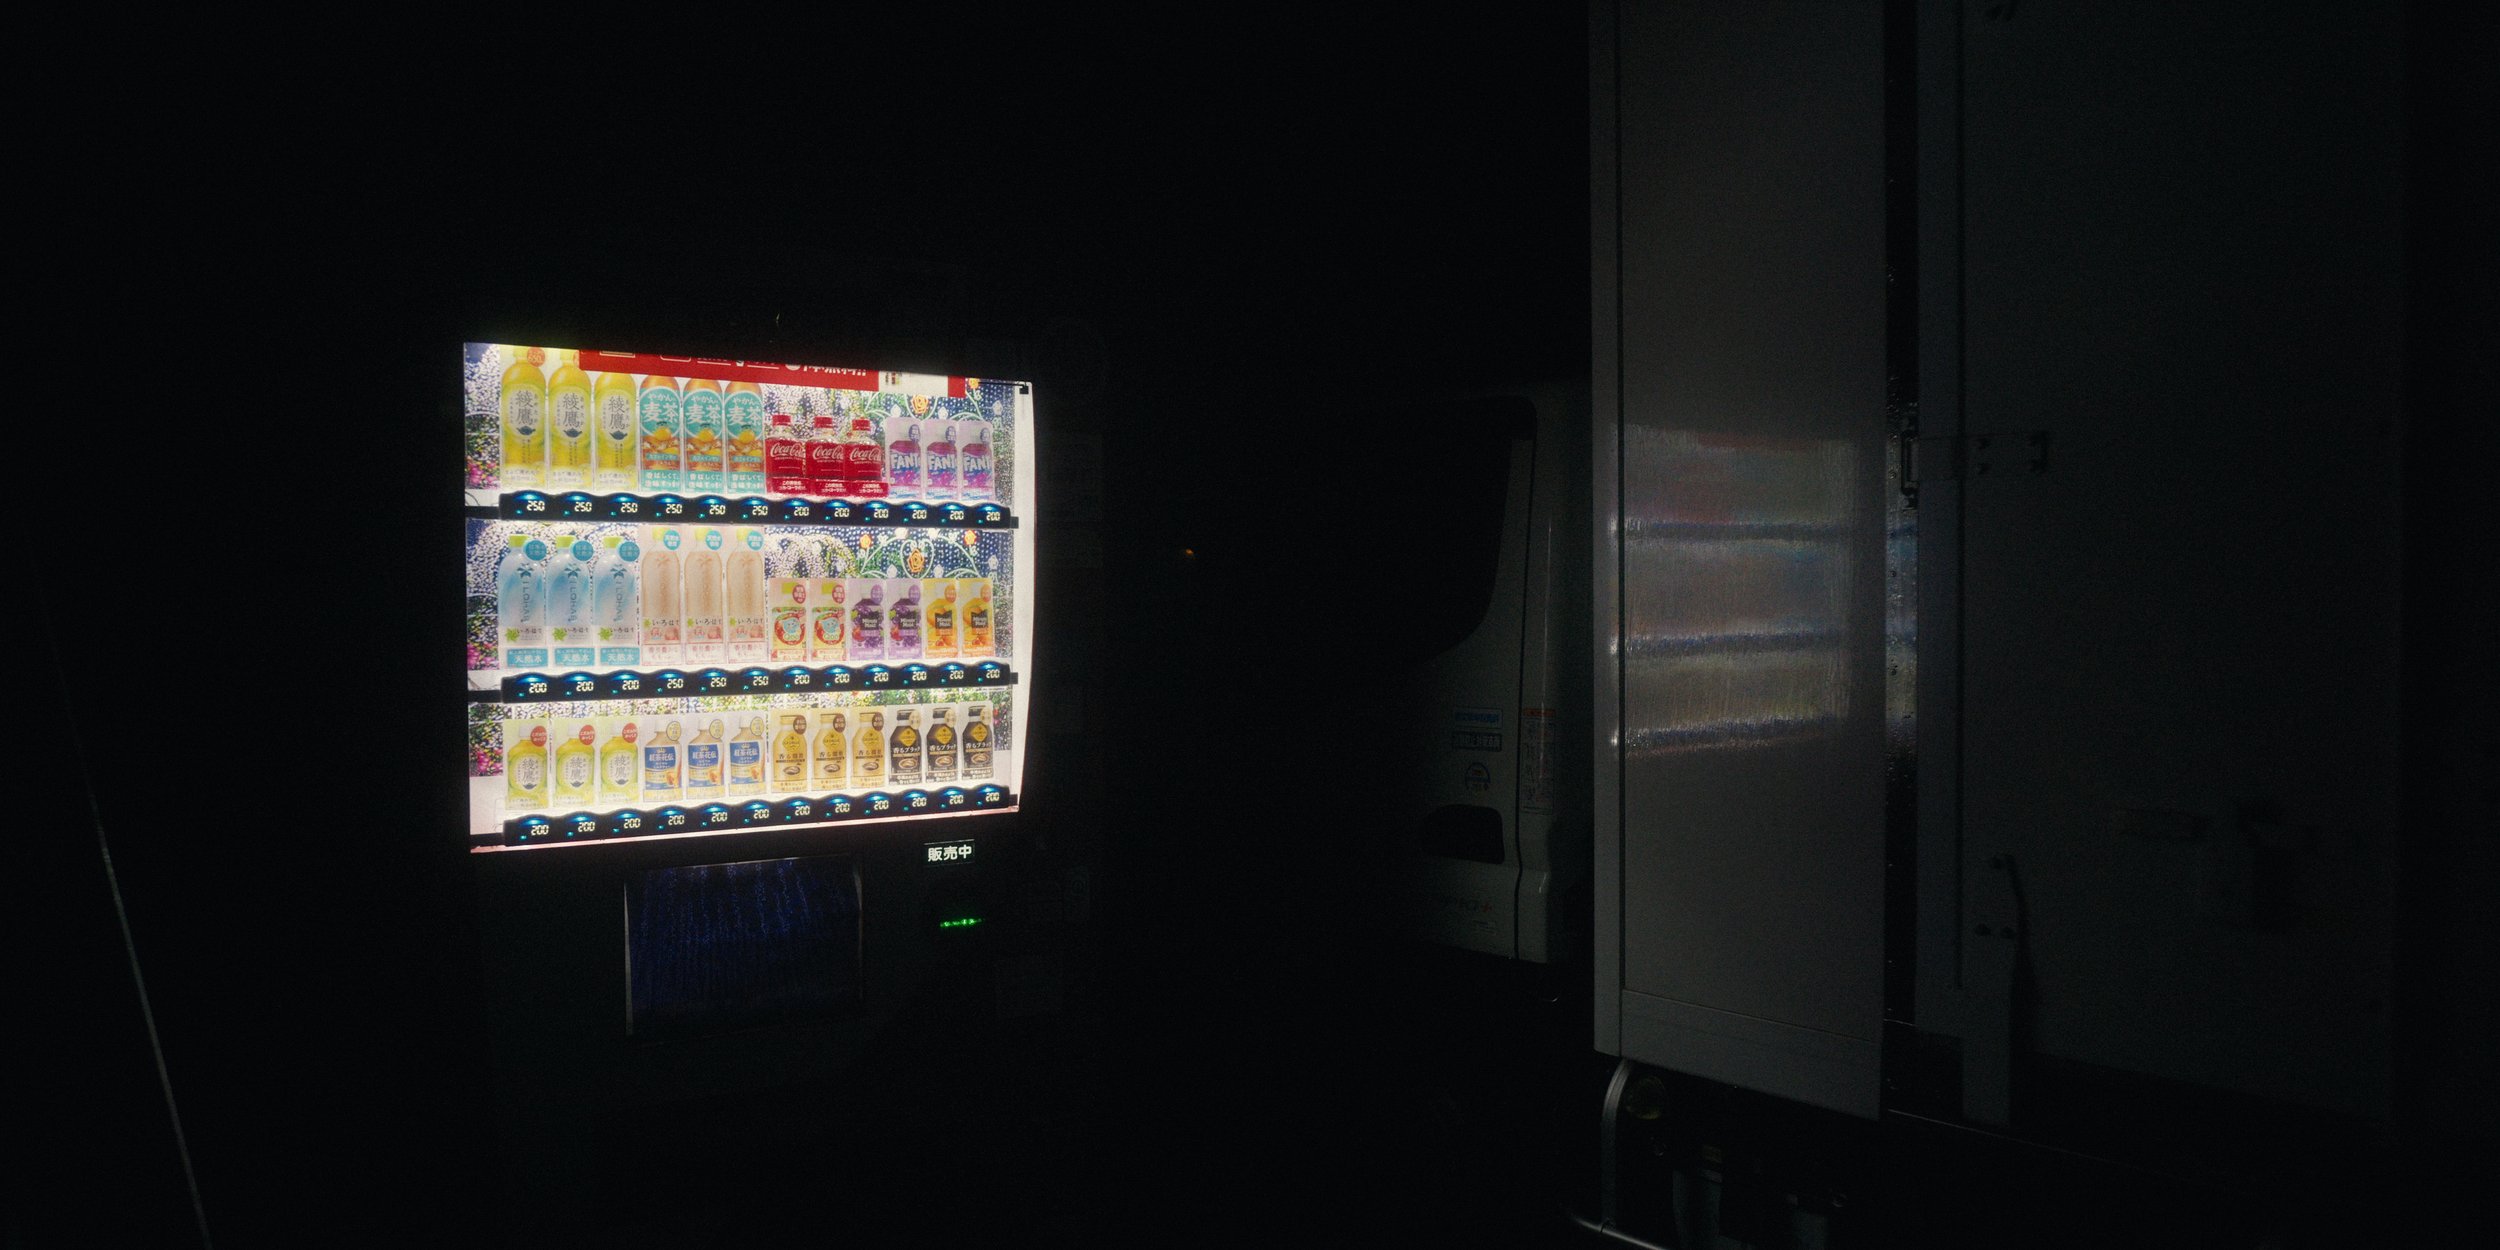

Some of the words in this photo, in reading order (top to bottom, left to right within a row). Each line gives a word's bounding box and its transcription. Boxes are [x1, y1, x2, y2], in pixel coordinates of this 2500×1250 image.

[515, 390, 533, 425] 綾鷹
[563, 392, 580, 427] 綾鷹
[608, 395, 626, 430] 綾鷹
[642, 402, 679, 423] 麦茶
[686, 404, 721, 425] 麦茶
[728, 406, 762, 426] 麦茶
[527, 500, 546, 511] 250
[574, 501, 593, 512] 250
[621, 502, 639, 513] 250
[666, 503, 683, 514] 250
[709, 504, 727, 515] 250
[752, 505, 769, 515] 250
[794, 506, 810, 516] 200
[834, 507, 850, 517] 200
[874, 508, 889, 518] 200
[912, 509, 928, 519] 200
[950, 510, 965, 520] 200
[986, 511, 1001, 521] 200
[835, 673, 850, 683] 200
[874, 671, 889, 682] 200
[912, 670, 928, 681] 200
[950, 669, 965, 679] 200
[986, 668, 1001, 678] 200
[622, 679, 640, 690] 200
[667, 678, 684, 688] 250
[711, 676, 727, 687] 250
[753, 675, 769, 686] 250
[794, 674, 811, 684] 200
[529, 682, 548, 693] 200
[576, 680, 595, 691] 200
[912, 796, 928, 807] 200
[949, 794, 964, 804] 200
[986, 791, 1000, 802] 200
[835, 802, 851, 813] 200
[874, 799, 890, 810] 200
[753, 808, 770, 819] 200
[795, 805, 811, 816] 200
[668, 814, 685, 825] 200
[711, 811, 728, 822] 200
[578, 821, 596, 832] 200
[624, 817, 642, 828] 200
[531, 824, 550, 835] 200
[928, 845, 972, 862] 販売中
